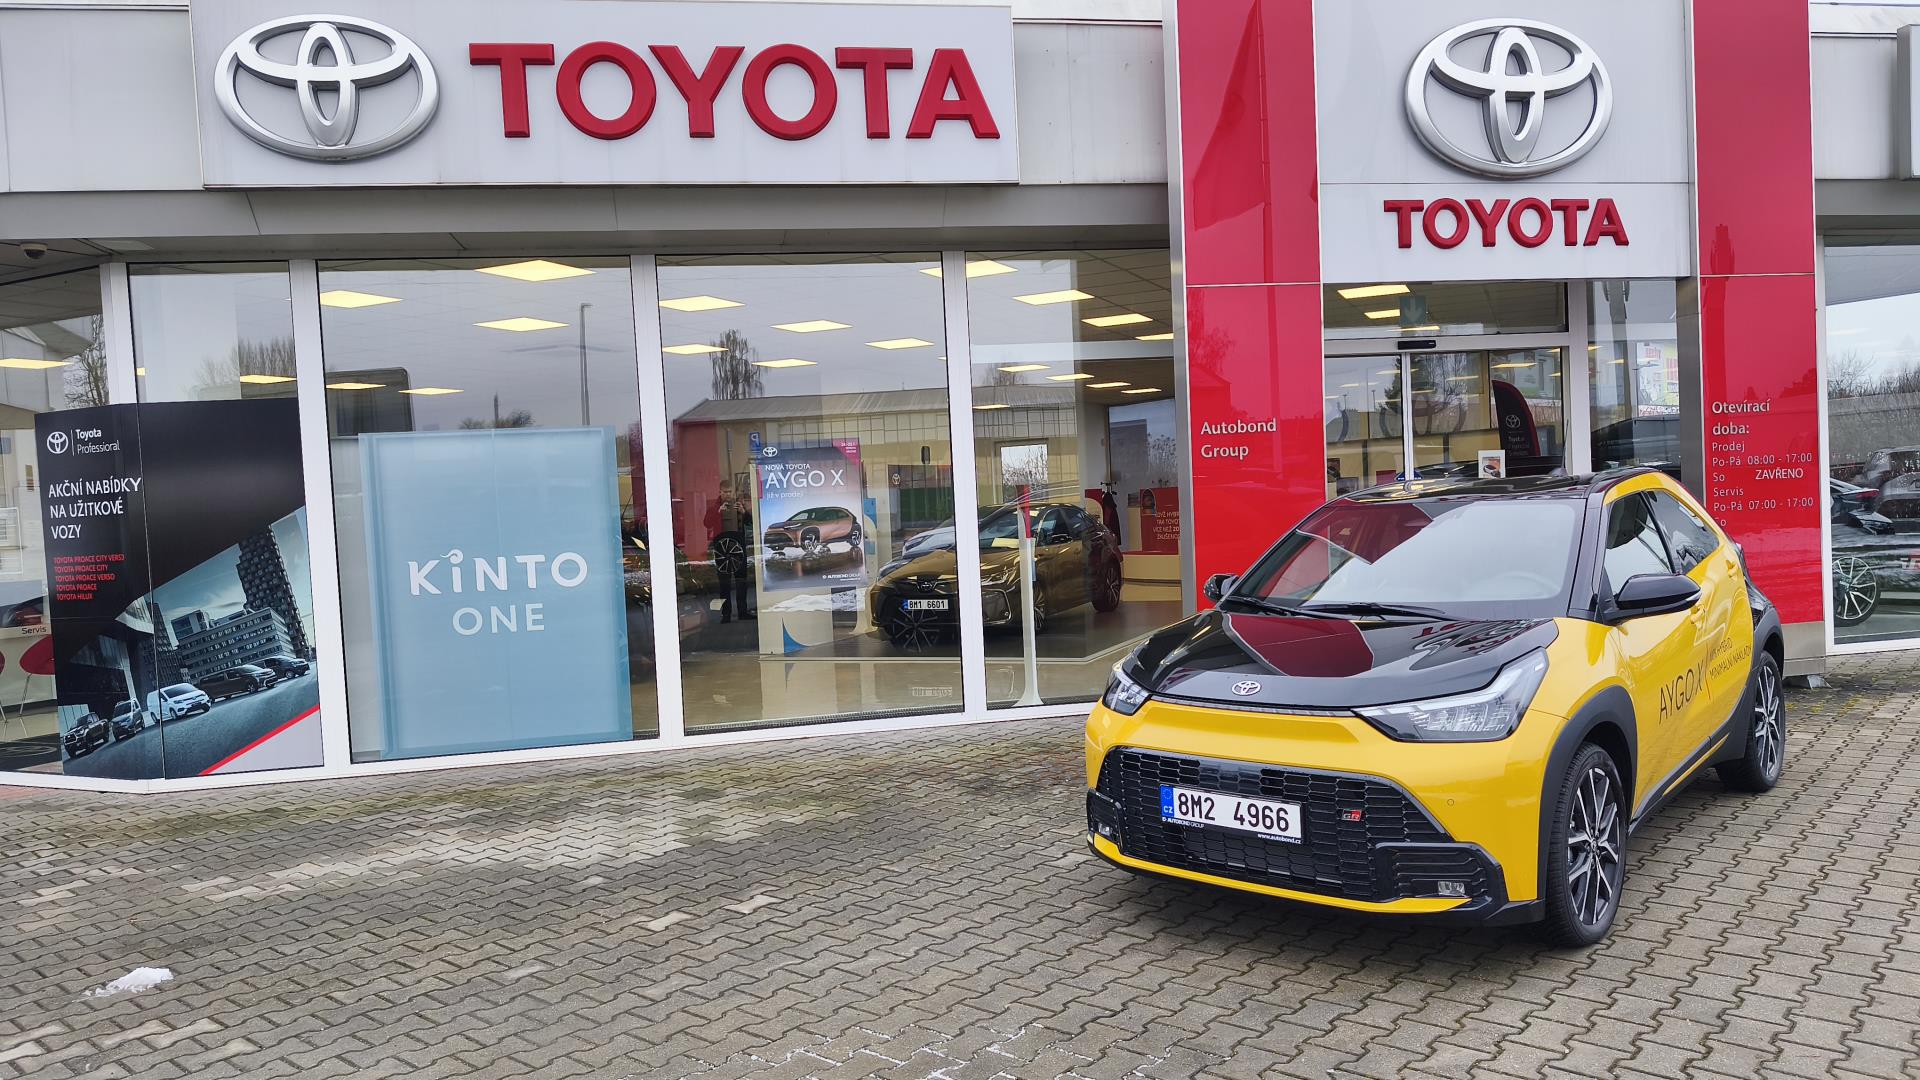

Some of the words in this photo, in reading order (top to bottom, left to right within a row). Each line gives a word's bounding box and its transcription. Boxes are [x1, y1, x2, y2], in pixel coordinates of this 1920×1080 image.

[469, 41, 1000, 140] TOYOTA
[1384, 197, 1629, 249] TOYOTA
[1712, 398, 1771, 414] Otevírací
[1201, 417, 1277, 435] Autobond
[1712, 421, 1750, 435] doba:
[75, 428, 102, 441] Toyota
[77, 439, 121, 455] Professional
[1201, 444, 1249, 460] Group
[1712, 441, 1745, 452] Prodej
[1712, 456, 1742, 467] Po-Pá
[1747, 454, 1775, 465] 08:00
[1785, 452, 1812, 463] 17:00
[765, 470, 825, 489] AYGO
[830, 469, 844, 486] X
[1713, 472, 1725, 482] So
[1755, 467, 1804, 480] ZAVŘENO
[48, 478, 83, 498] AKČNÍ
[86, 475, 142, 496] NABÍDKY
[1713, 486, 1744, 497] Servis
[50, 504, 67, 519] NA
[69, 496, 124, 518] UŽITKOVÉ
[1713, 501, 1743, 512] Po-Pá
[1748, 499, 1776, 510] 07:00
[1787, 497, 1814, 508] 17:00
[1714, 517, 1727, 526] o
[51, 524, 82, 540] VOZY
[95, 554, 108, 562] CITY
[54, 565, 74, 573] TOYOTA
[56, 584, 76, 592] TOYOTA
[56, 593, 76, 601] TOYOTA
[452, 603, 546, 636] ONE
[21, 626, 47, 635] Servis
[1659, 668, 1695, 725] AYGO
[1695, 659, 1704, 696] X
[1163, 805, 1174, 814] CZ
[1177, 792, 1216, 821] 8M2
[1233, 801, 1290, 832] 4966
